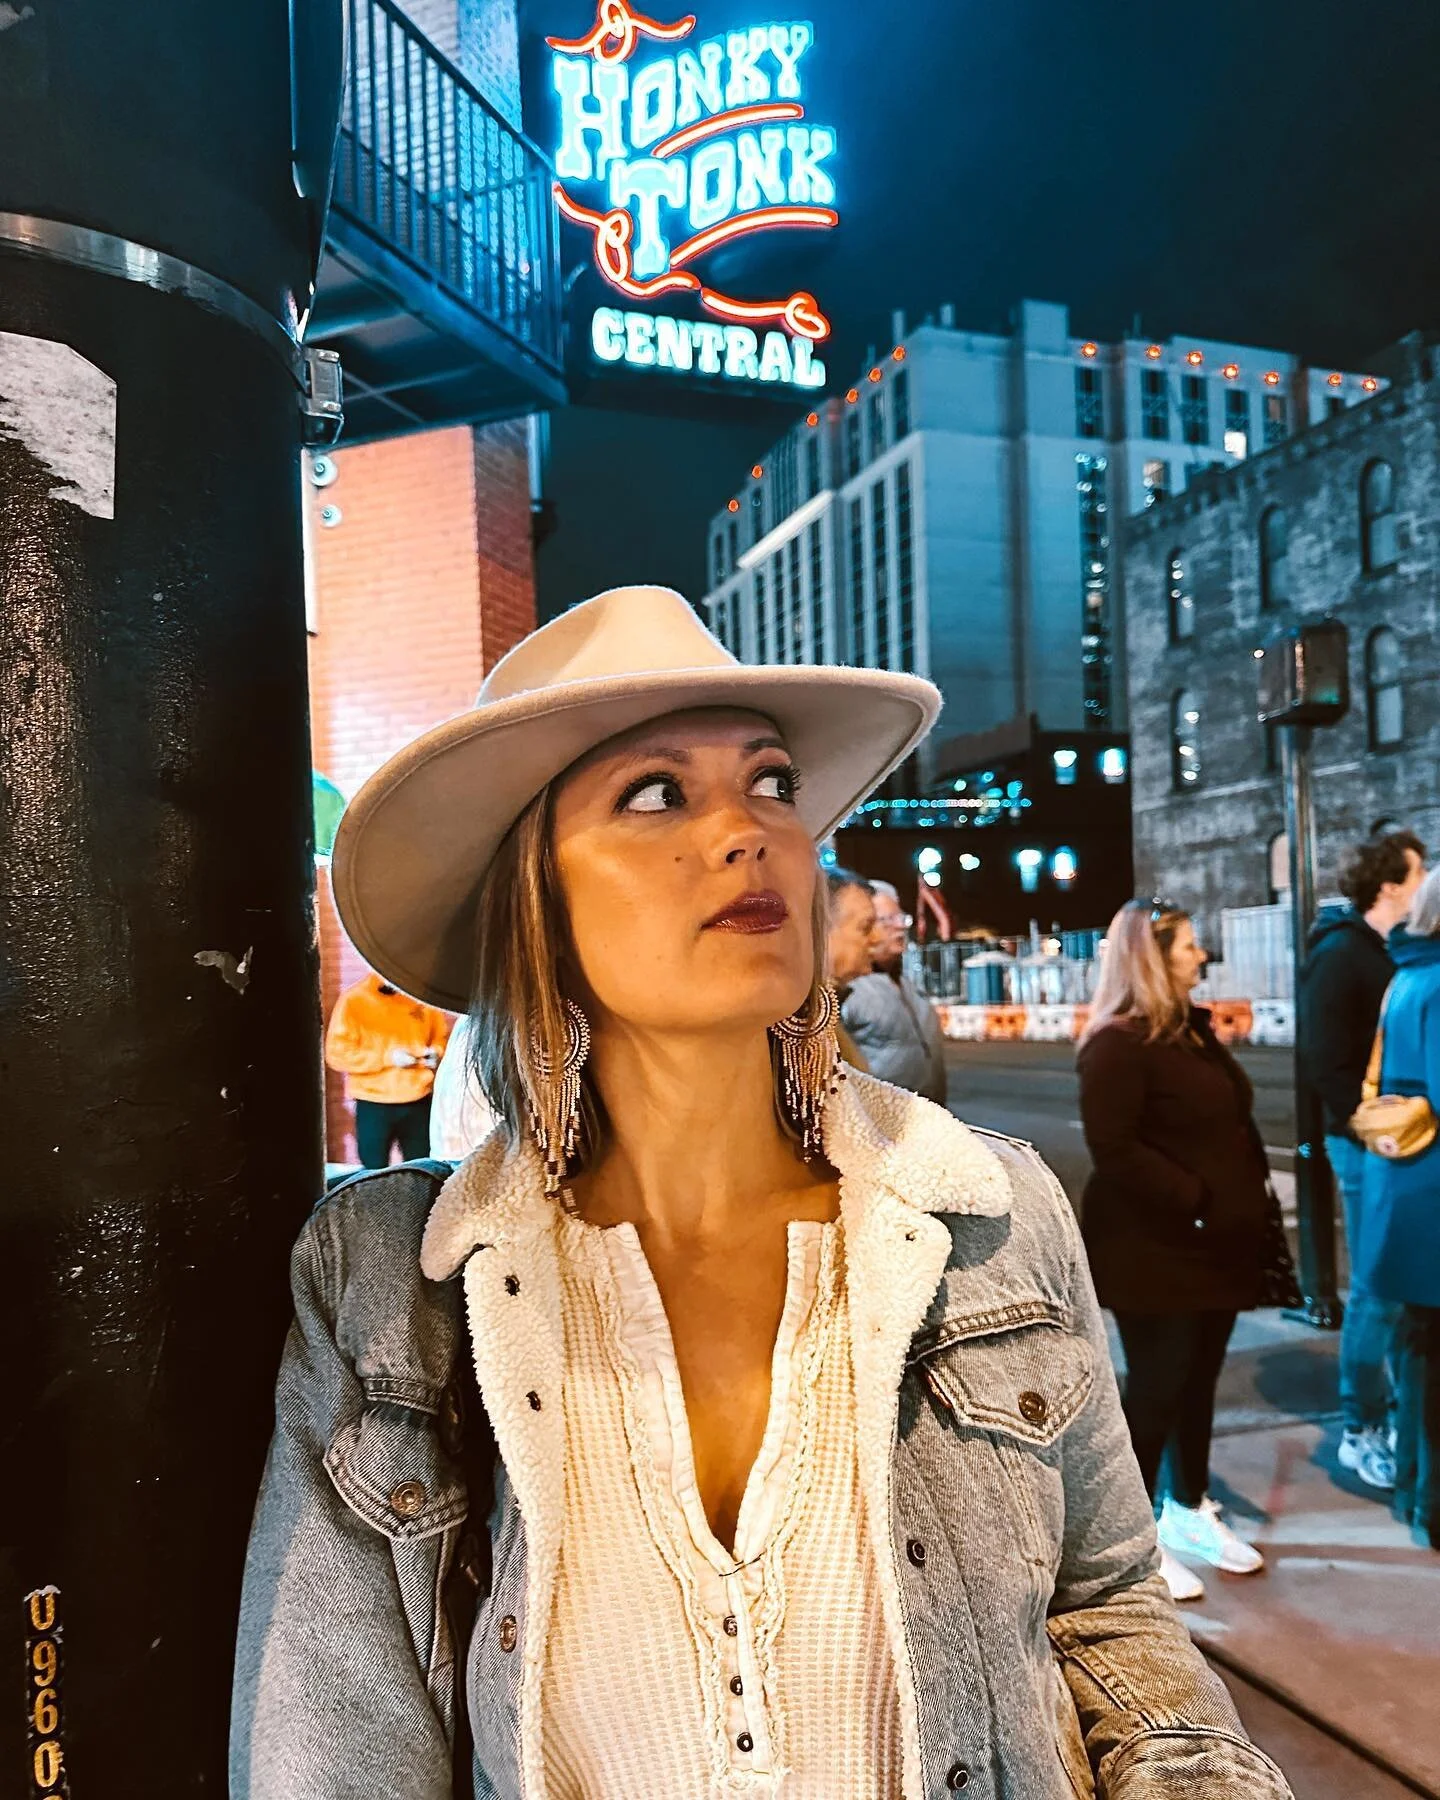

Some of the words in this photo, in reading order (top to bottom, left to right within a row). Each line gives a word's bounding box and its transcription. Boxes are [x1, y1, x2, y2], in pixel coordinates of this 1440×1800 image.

[553, 21, 814, 181] HONKY
[609, 123, 836, 278] TONK
[591, 307, 826, 387] CENTRAL
